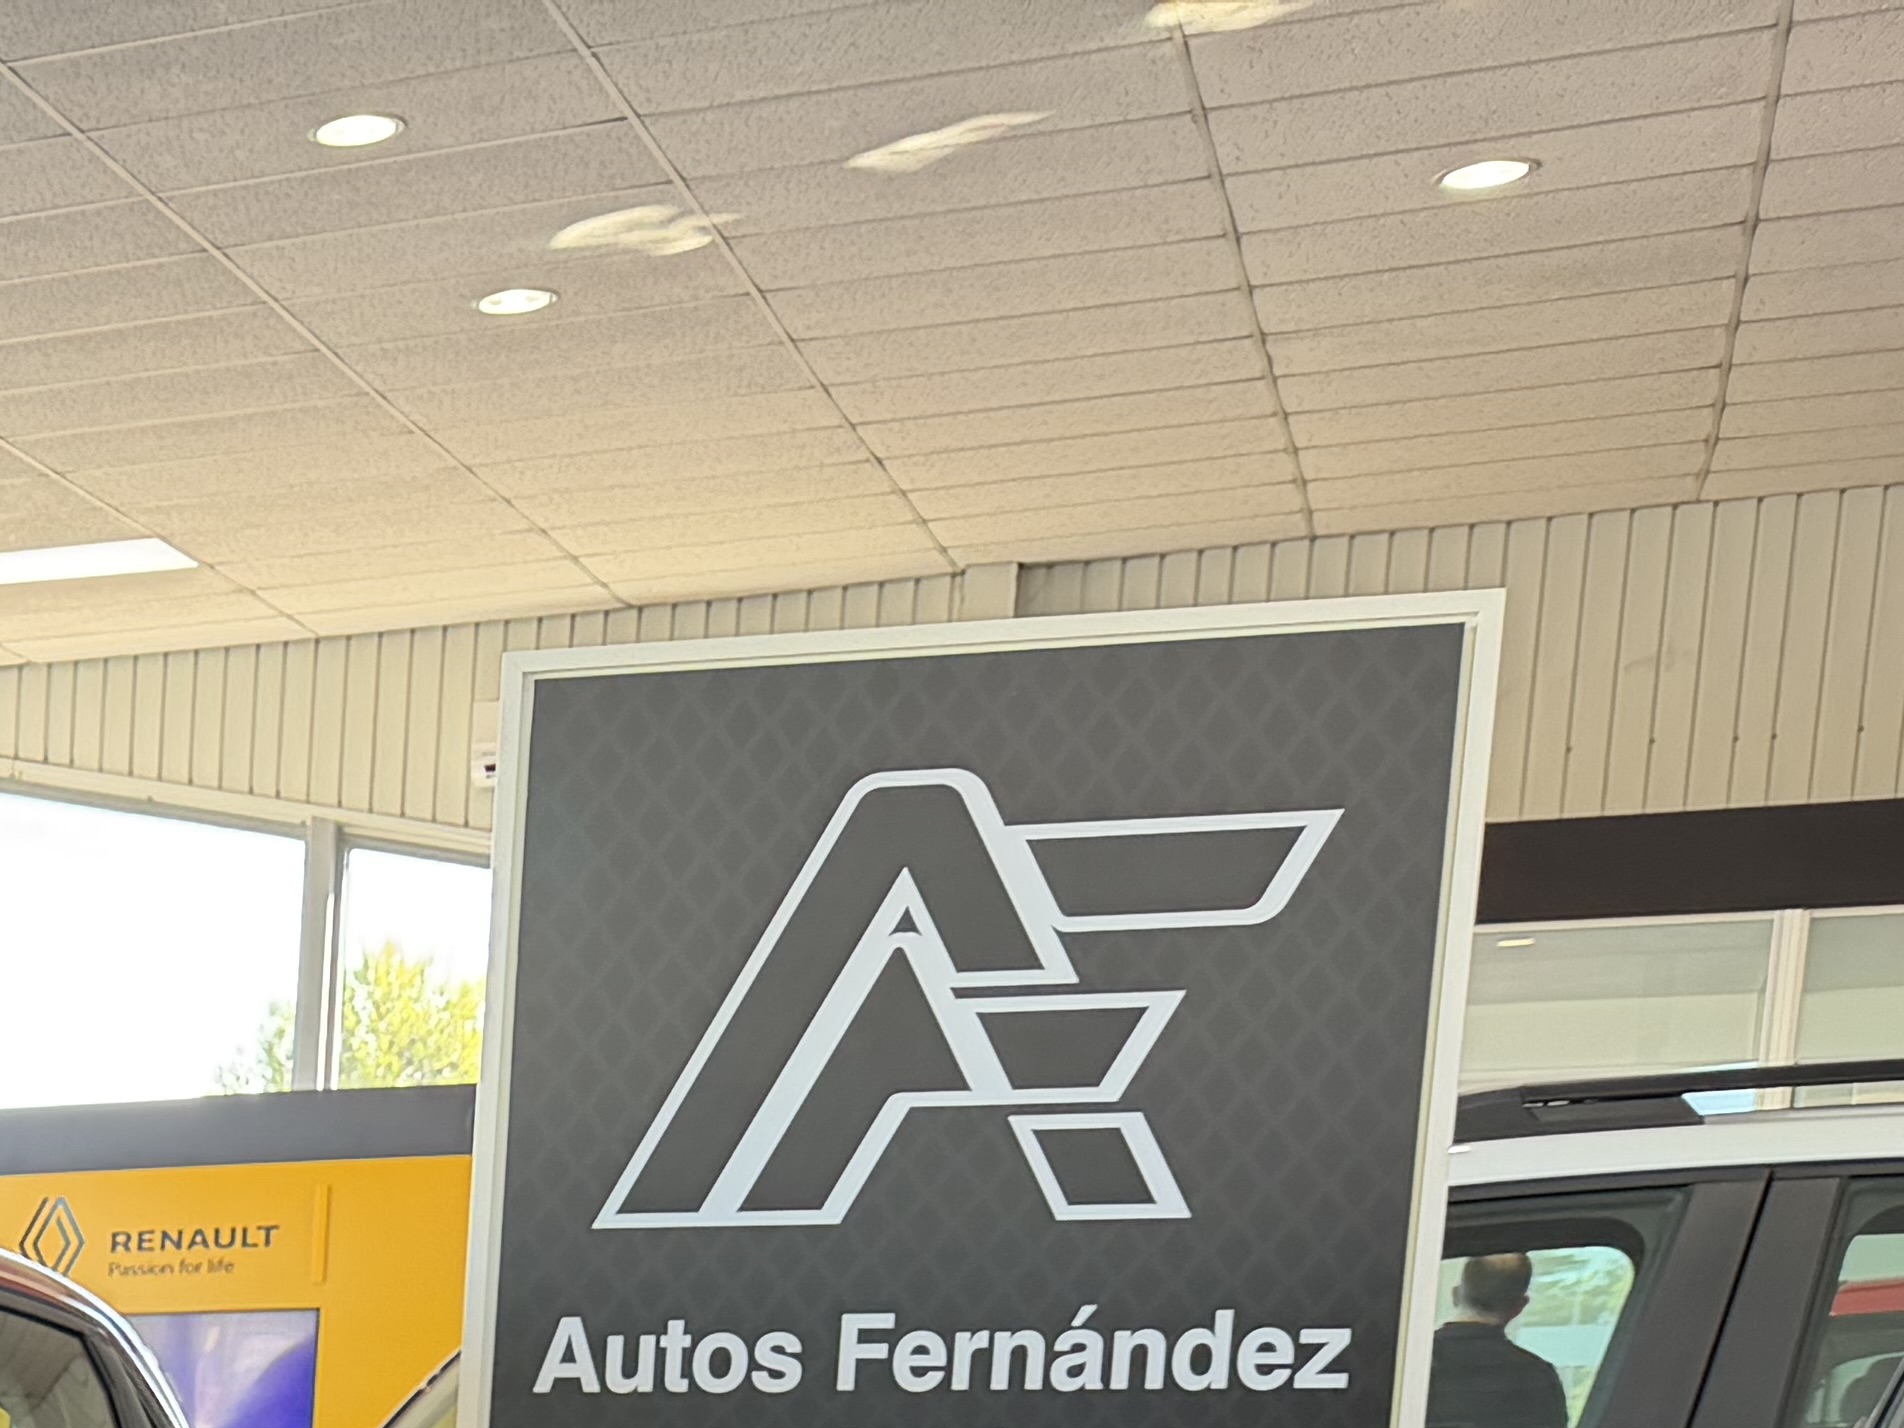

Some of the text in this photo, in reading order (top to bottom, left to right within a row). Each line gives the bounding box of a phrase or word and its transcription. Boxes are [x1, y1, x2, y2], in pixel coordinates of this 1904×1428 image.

[109, 1224, 280, 1254] RENAULT
[107, 1256, 236, 1278] Passion for life
[532, 1303, 1354, 1395] Autos Fernández
